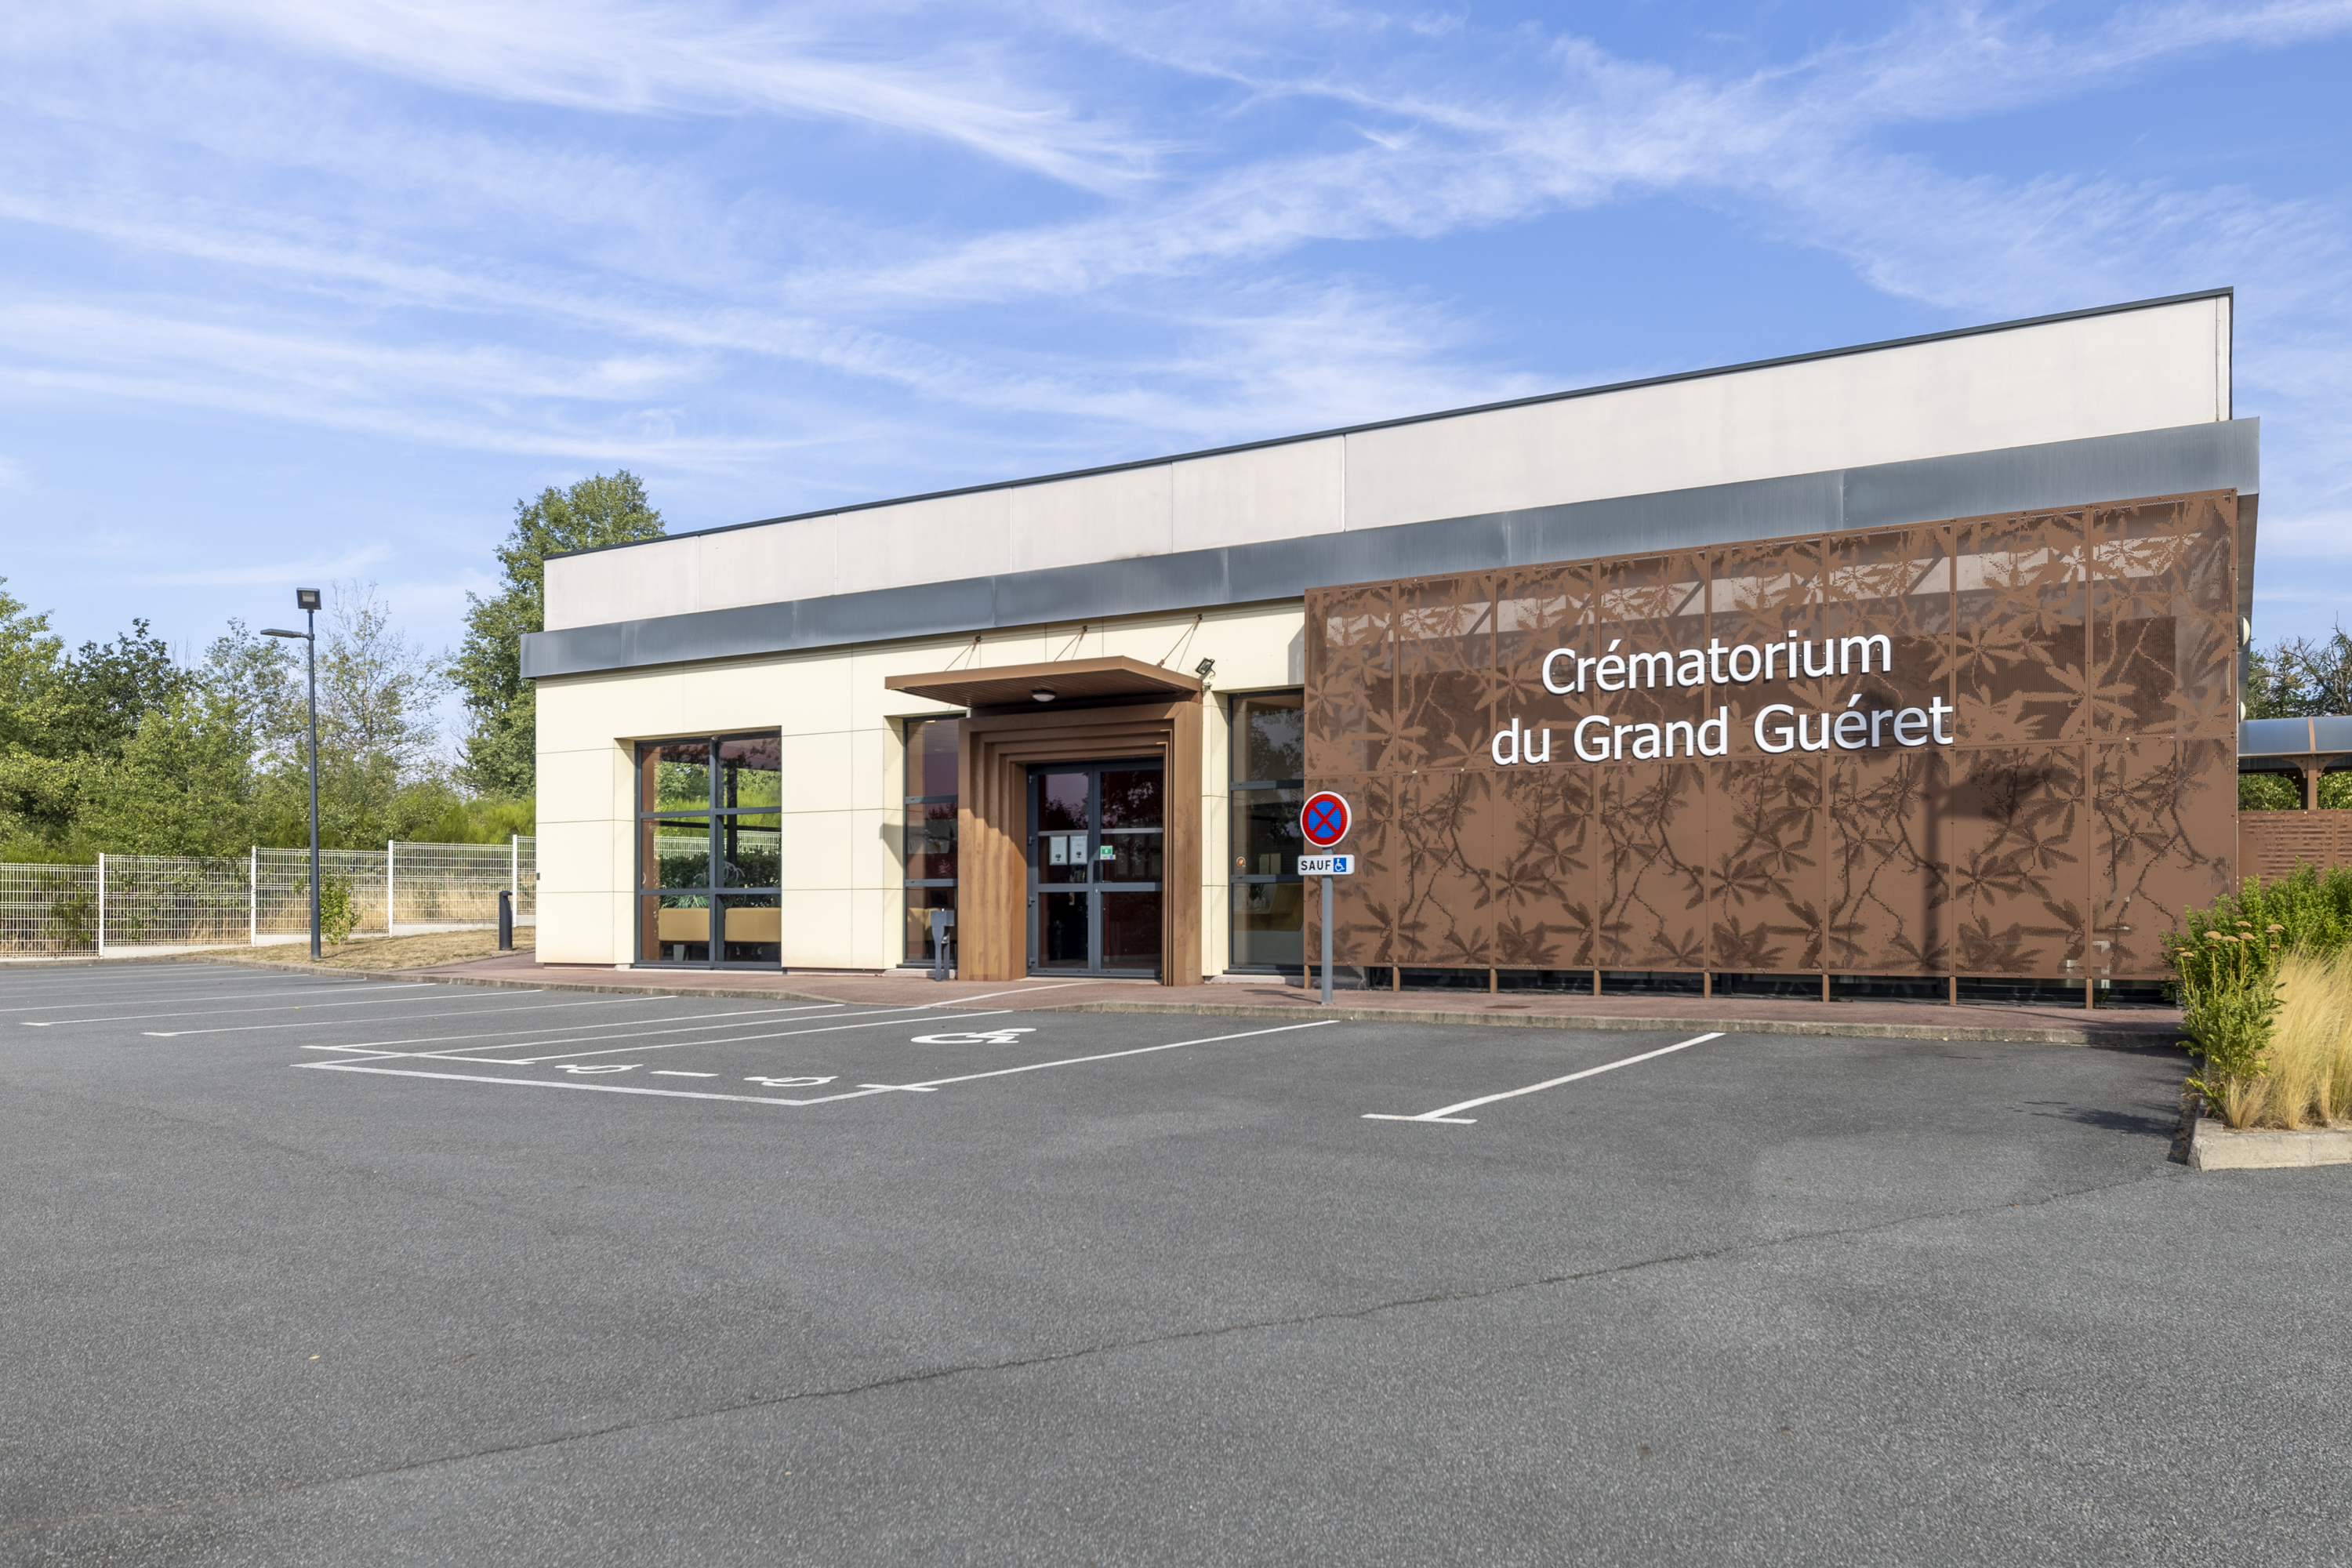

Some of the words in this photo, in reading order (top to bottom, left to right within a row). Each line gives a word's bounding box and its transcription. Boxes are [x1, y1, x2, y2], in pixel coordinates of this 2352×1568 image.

[1542, 630, 1892, 695] Crématorium
[1491, 717, 1551, 765] du
[1573, 706, 1729, 763] Grand
[1754, 693, 1955, 754] Guéret
[1301, 860, 1331, 871] SAUF
